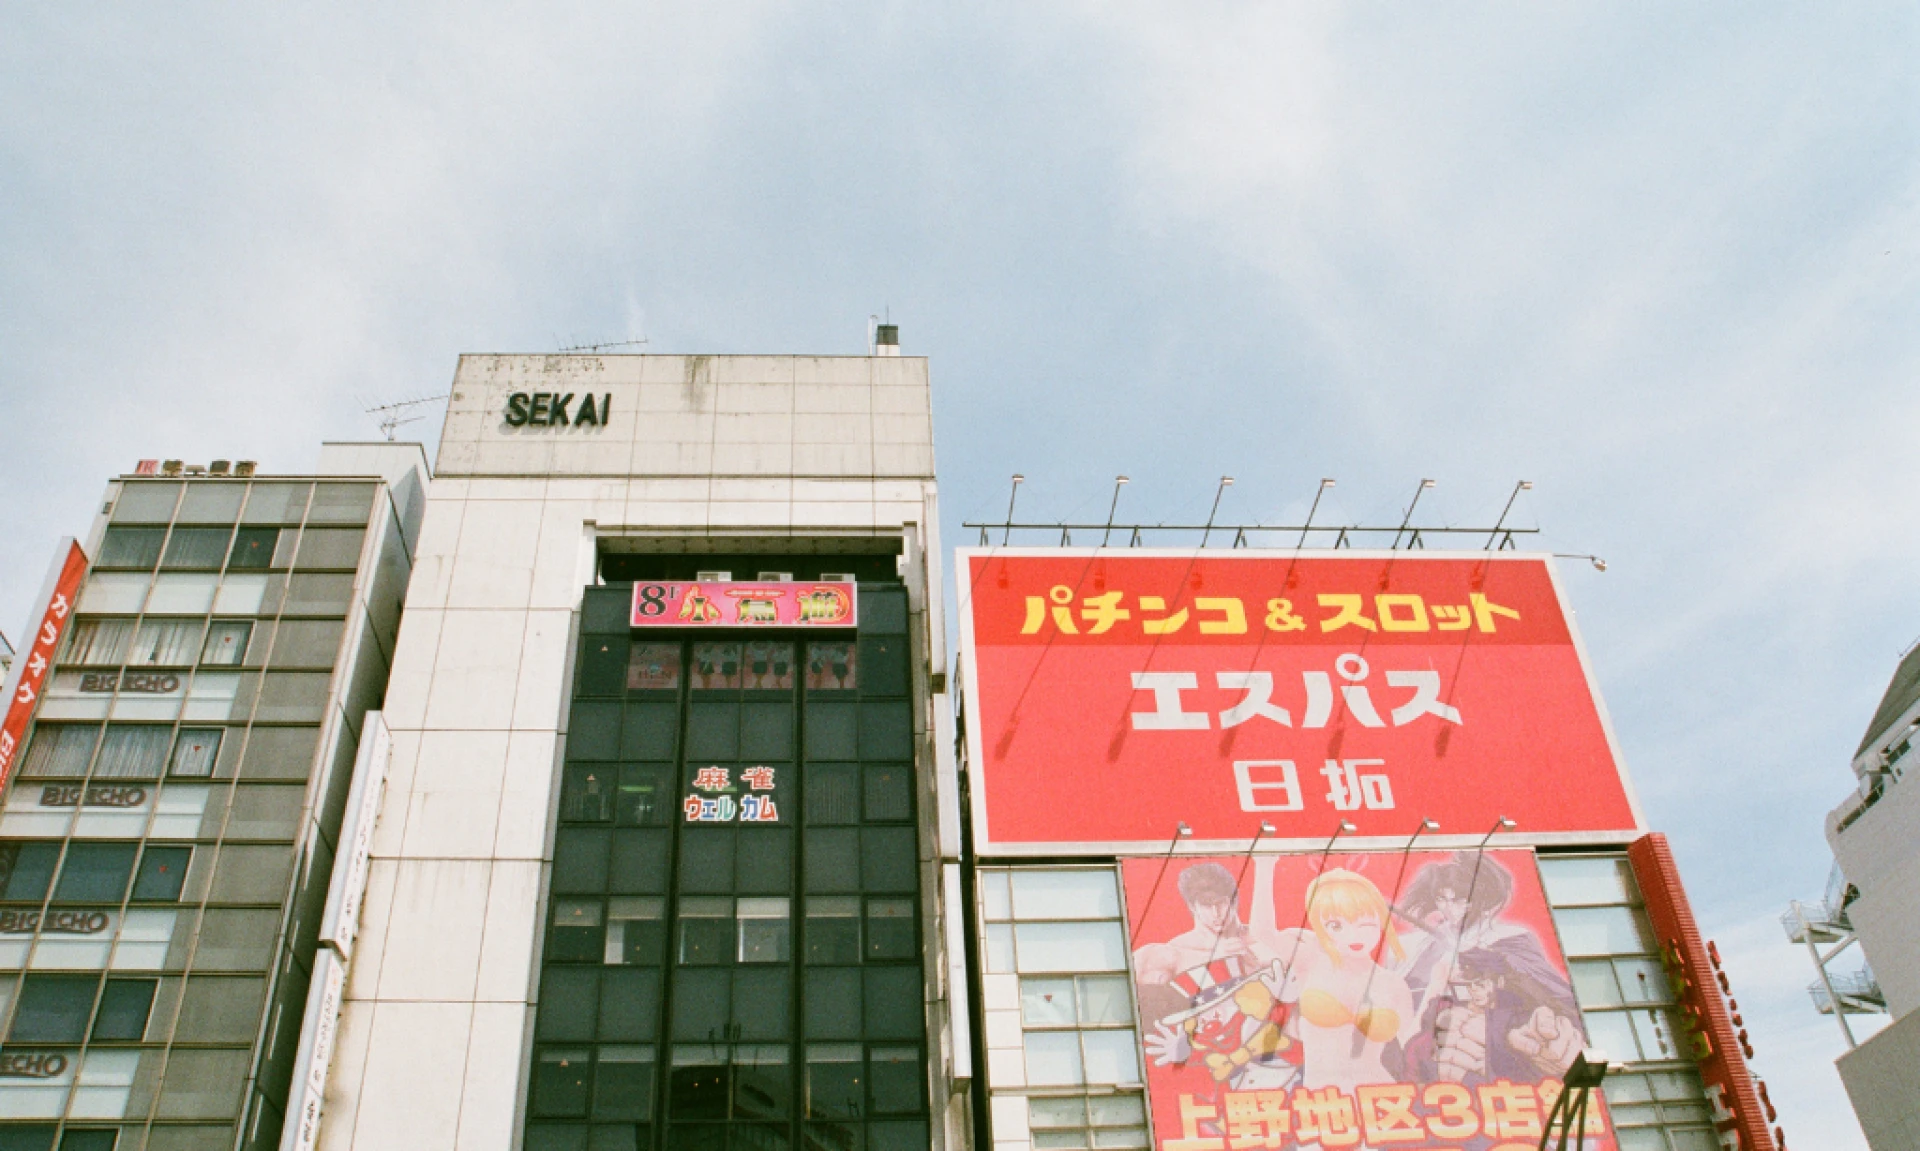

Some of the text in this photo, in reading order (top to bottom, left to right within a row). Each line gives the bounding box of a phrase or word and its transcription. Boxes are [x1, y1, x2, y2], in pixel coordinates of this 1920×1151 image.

[505, 392, 611, 427] SEKAI
[1021, 585, 1521, 634] パチンコ & スロット
[17, 592, 69, 704] カラオケ
[1130, 652, 1463, 731] エスパス
[692, 765, 775, 791] 麻雀
